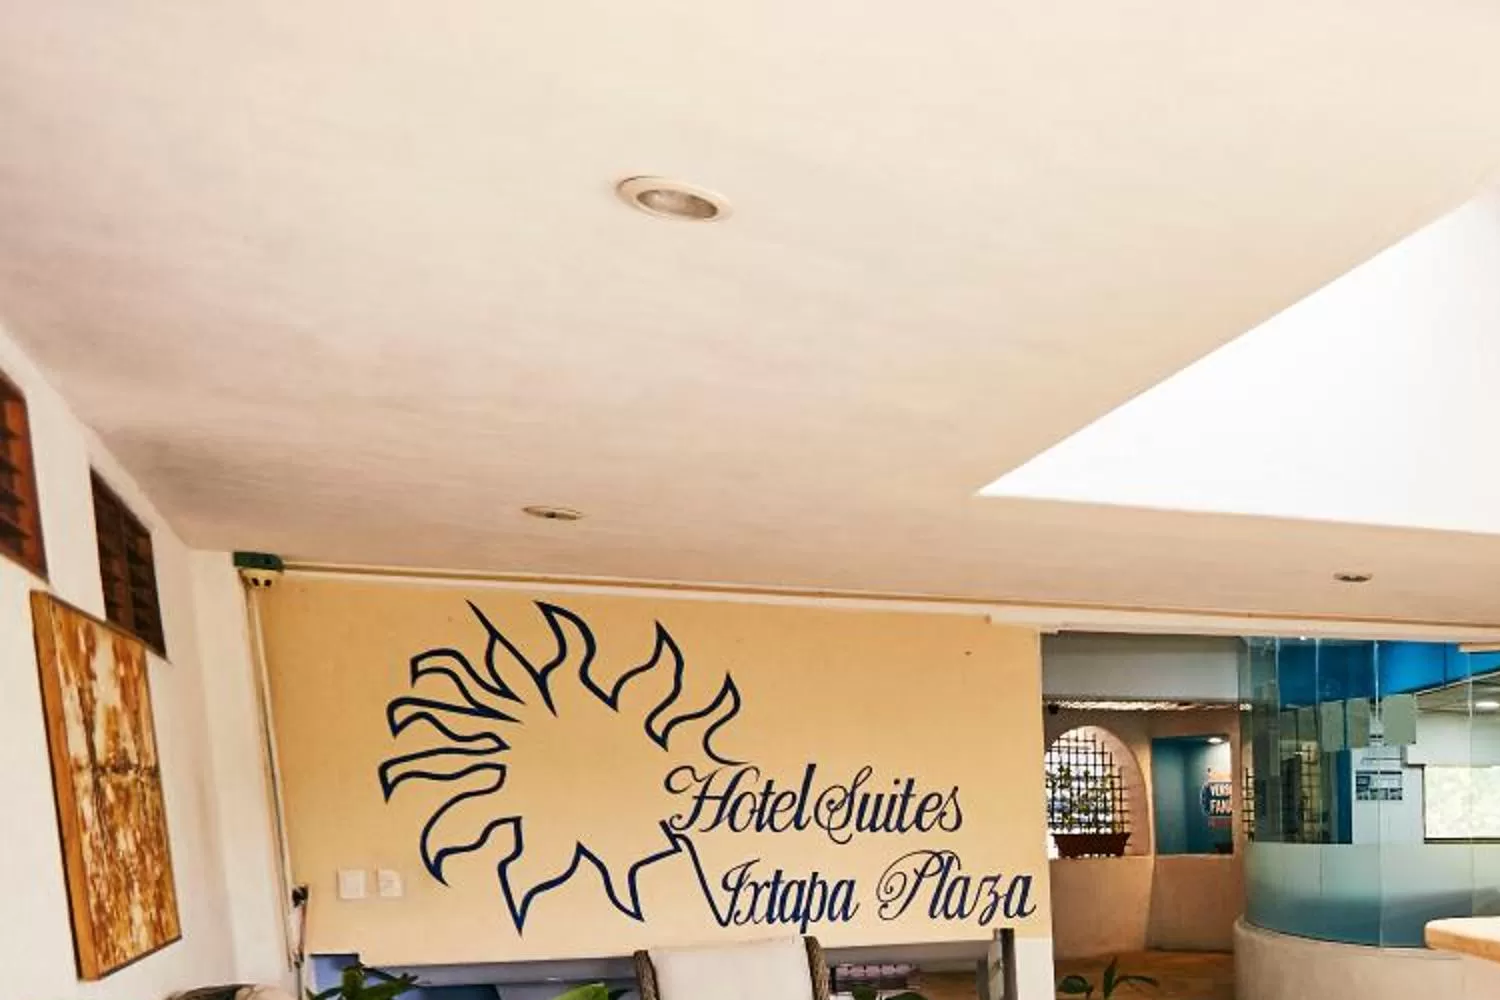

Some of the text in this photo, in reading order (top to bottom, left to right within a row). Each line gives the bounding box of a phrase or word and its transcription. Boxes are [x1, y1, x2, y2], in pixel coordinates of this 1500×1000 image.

[664, 763, 963, 845] Hotel Suites
[721, 850, 1037, 934] Ixtapa Plaza
